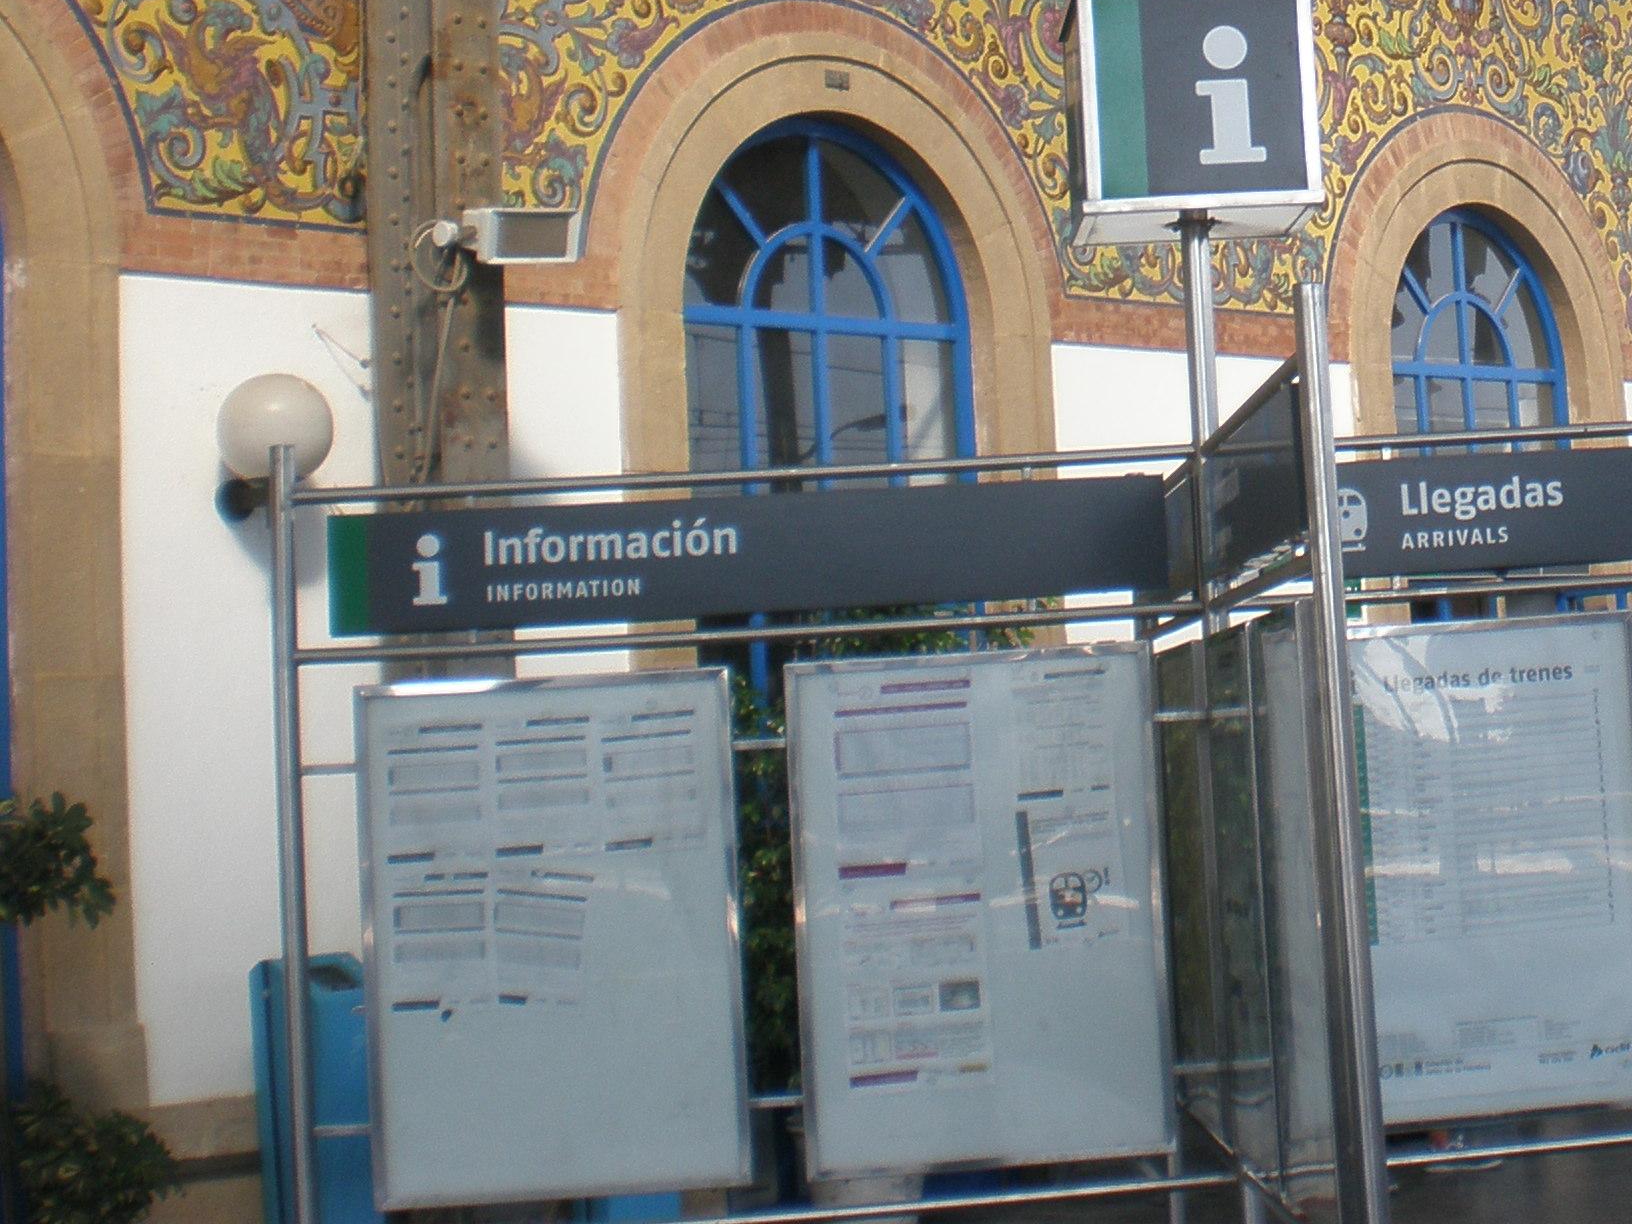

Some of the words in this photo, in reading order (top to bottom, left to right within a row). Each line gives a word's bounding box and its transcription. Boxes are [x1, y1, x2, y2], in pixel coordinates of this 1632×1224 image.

[1400, 475, 1564, 521] Llegadas
[482, 517, 738, 567] Información
[1402, 526, 1509, 550] ARRIVALS
[486, 578, 642, 603] INFORMATION
[1383, 670, 1471, 695] Llegadas
[1478, 667, 1503, 687] de
[1509, 663, 1573, 684] trenes
